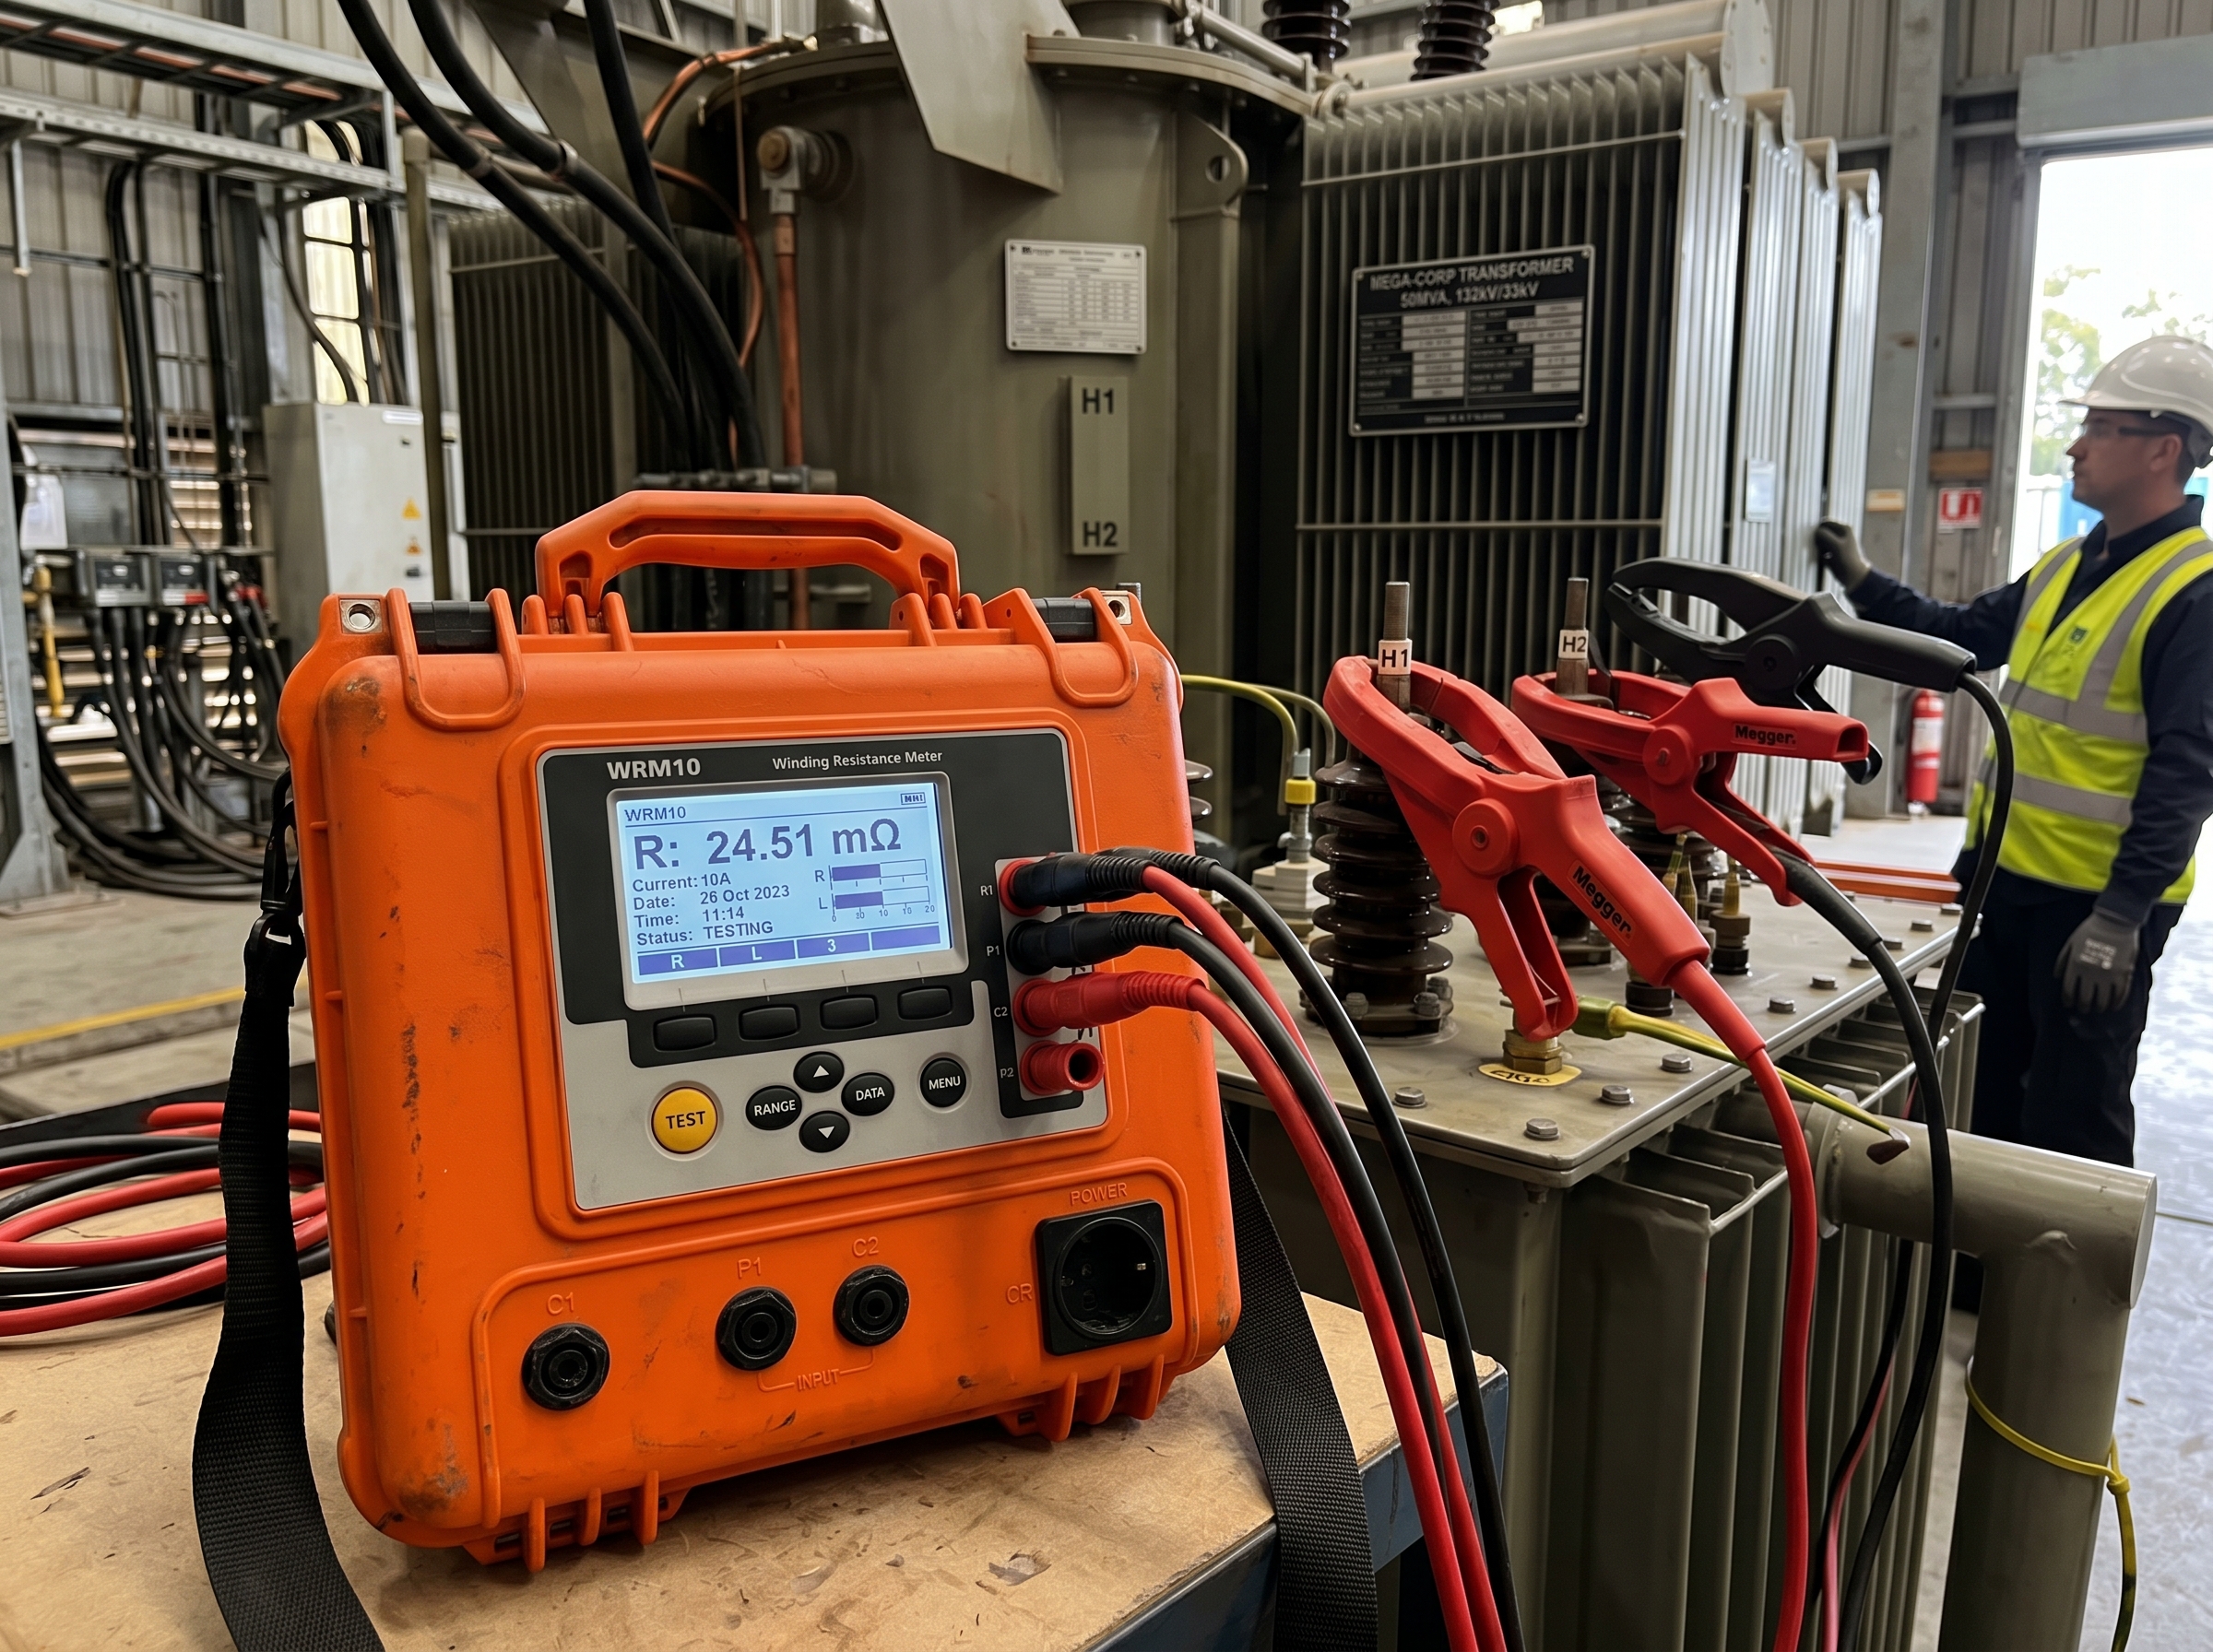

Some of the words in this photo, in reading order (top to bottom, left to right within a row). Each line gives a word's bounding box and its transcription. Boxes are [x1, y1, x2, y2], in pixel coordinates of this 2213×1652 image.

[1460, 257, 1574, 283] TRANSFORMER
[1082, 388, 1114, 414] H1
[1083, 521, 1118, 547] H2
[1562, 635, 1587, 653] H2
[1381, 648, 1409, 668] H1
[606, 758, 701, 780] WRM10
[772, 757, 830, 771] Winding
[833, 752, 902, 767] Resistance
[905, 750, 943, 763] Meter
[624, 806, 687, 821] WRM10
[633, 834, 680, 870] R:
[706, 824, 813, 865] 24.51
[832, 818, 902, 855] mΩ
[633, 876, 698, 892] Current:
[702, 872, 731, 887] 10A
[814, 869, 825, 882] R
[633, 896, 676, 911] Date:
[700, 891, 718, 905] 26
[722, 889, 750, 903] Oct
[753, 884, 790, 901] 2023
[980, 885, 994, 896] R1
[819, 897, 828, 909] L
[633, 914, 680, 928] Time:
[702, 906, 745, 922] 11:14
[636, 930, 693, 946] Status:
[703, 920, 774, 939] TESTING
[670, 954, 685, 969] R
[751, 946, 763, 961] L
[827, 938, 836, 952] 3
[987, 946, 1000, 957] P1
[994, 1007, 1009, 1018] C2
[929, 1076, 961, 1091] MENU
[856, 1087, 885, 1102] DATA
[754, 1100, 796, 1116] RANGE
[666, 1111, 706, 1129] TEST
[1070, 1182, 1128, 1206] POWER
[852, 1236, 879, 1257] C2
[738, 1257, 762, 1279] P1
[1006, 1282, 1033, 1304] CR
[547, 1292, 574, 1316] C1
[798, 1368, 839, 1391] INPUT
